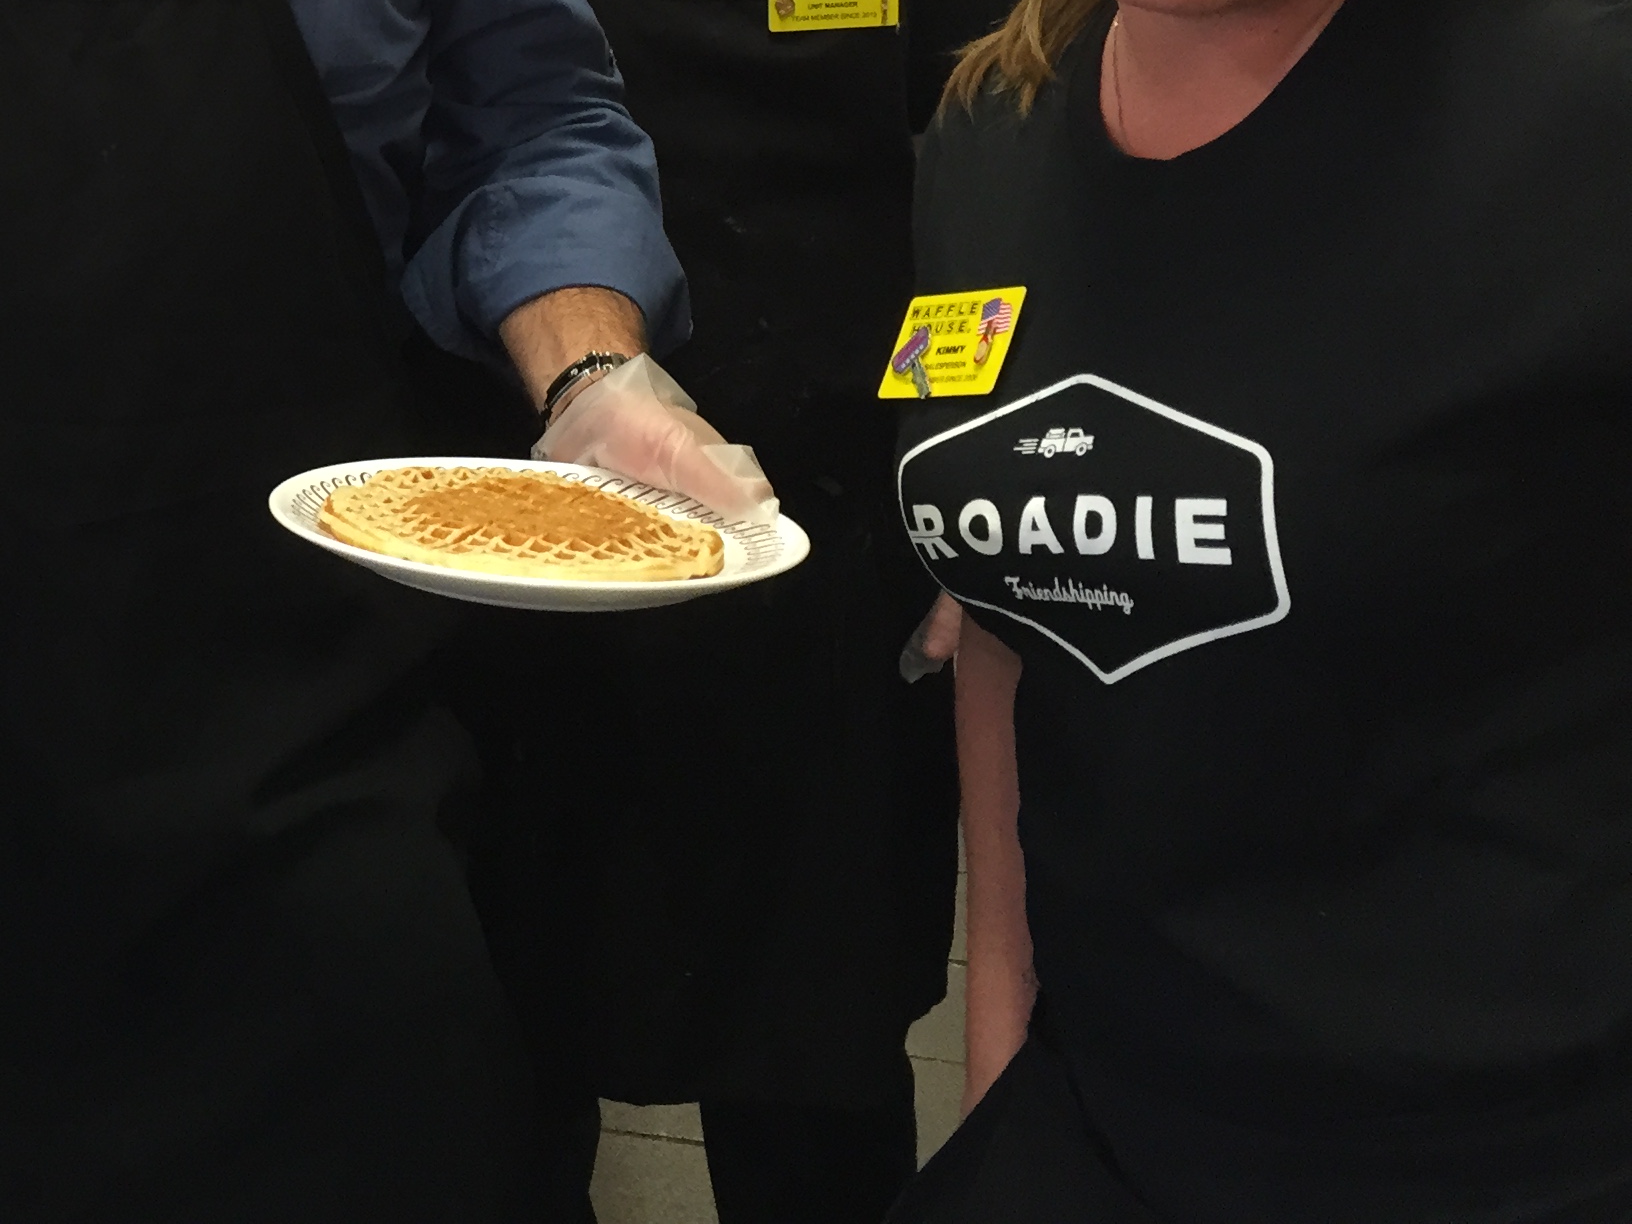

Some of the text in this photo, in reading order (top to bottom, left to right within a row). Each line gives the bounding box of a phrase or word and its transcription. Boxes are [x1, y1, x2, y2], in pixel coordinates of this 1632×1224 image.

[910, 302, 980, 319] WAFFLE
[935, 345, 967, 356] KIMMY
[911, 493, 1233, 566] ROADIE
[1004, 576, 1135, 615] Friendshipping
